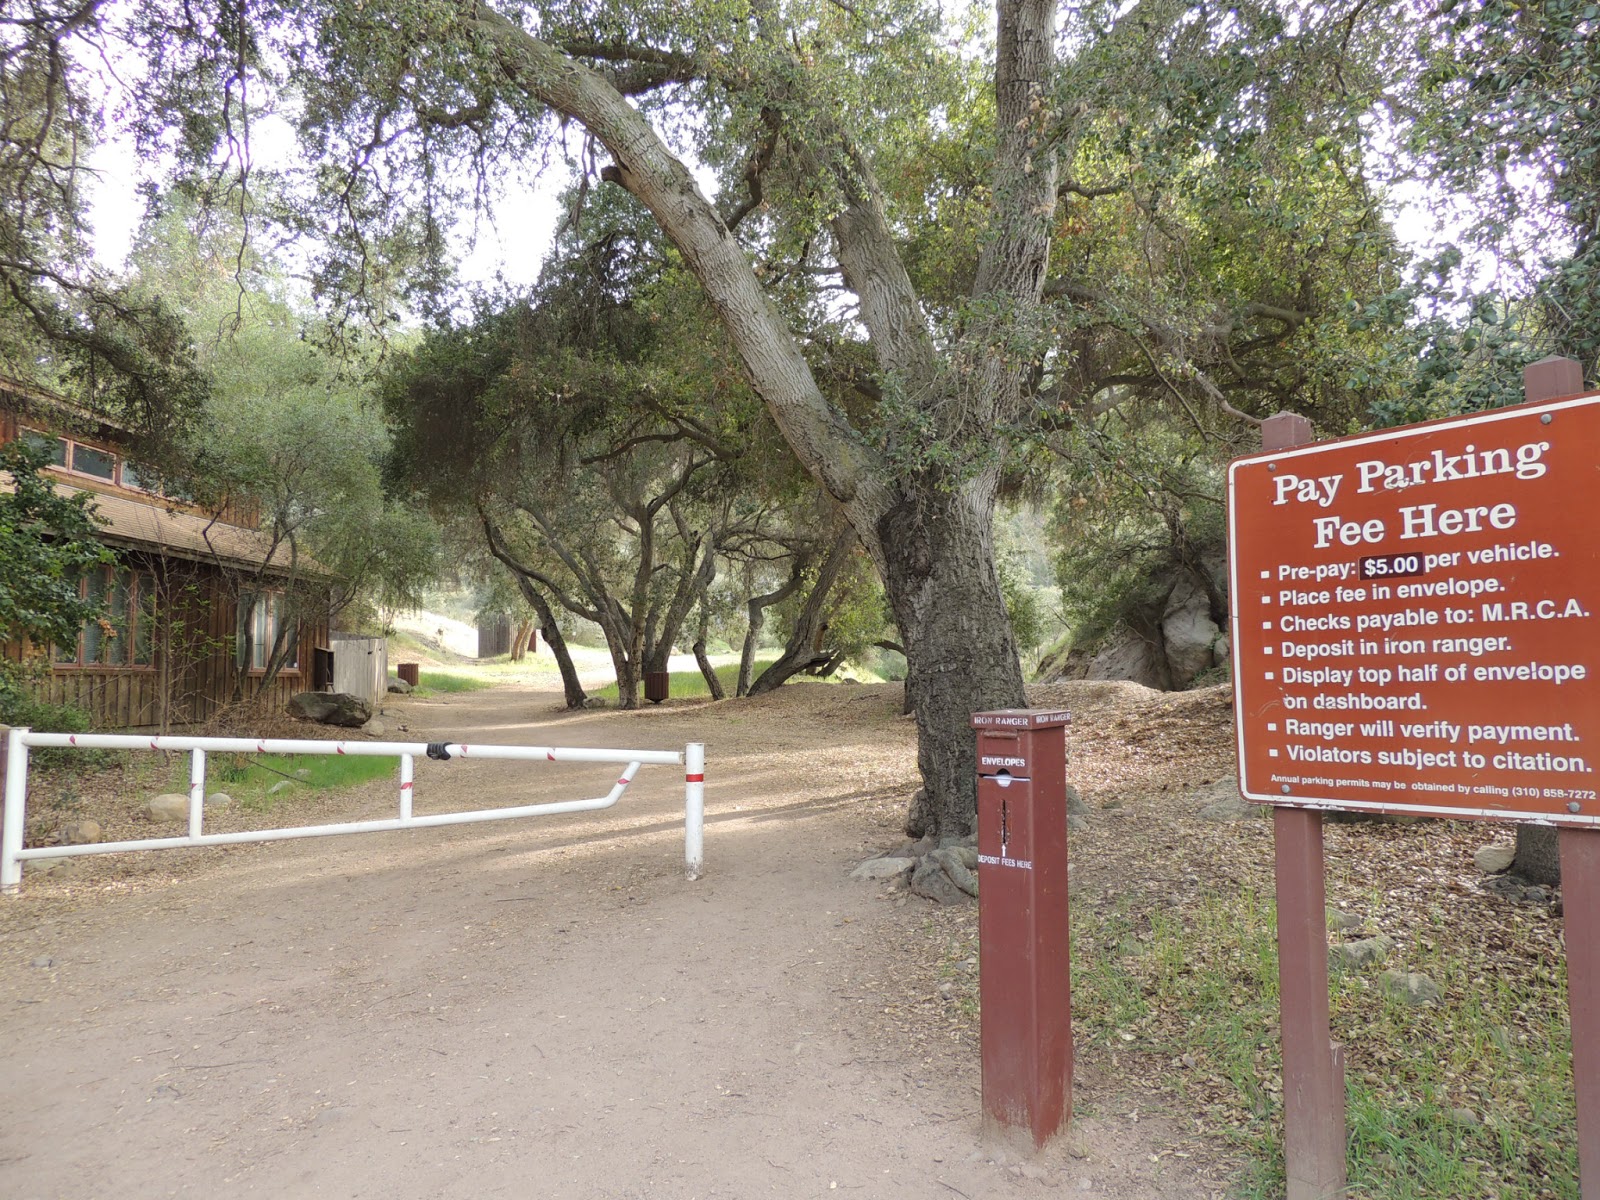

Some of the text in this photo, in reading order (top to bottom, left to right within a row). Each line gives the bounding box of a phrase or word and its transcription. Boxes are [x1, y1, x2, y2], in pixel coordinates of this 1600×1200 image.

[1273, 441, 1550, 507] Pay Parking
[1314, 503, 1516, 548] Fee Here
[1279, 541, 1559, 581] Pre-pay: $5.00 per vehicle.
[1280, 577, 1505, 606] Place fee in envelope.
[1280, 599, 1590, 632] Checks payable to: M.R.C.A.
[1282, 636, 1512, 660] Deposit in iron ranger.
[1283, 662, 1585, 687] Display top half of envelope
[1284, 693, 1427, 709] on dashboard.
[1286, 720, 1580, 744] Ranger will verify payment.
[982, 757, 1025, 766] ENVELOPES
[1287, 745, 1592, 772] Violators subject to citation.
[1271, 774, 1300, 783] Annual
[1302, 776, 1334, 787] parking
[1336, 778, 1369, 788] permits
[1372, 780, 1392, 790] may
[1394, 781, 1406, 789] be
[1411, 782, 1455, 792] obtained
[1458, 784, 1470, 794] by
[1473, 785, 1509, 796] calling
[1512, 786, 1540, 798] (310)
[978, 854, 1032, 869] DEPOSIT FEES HERE
